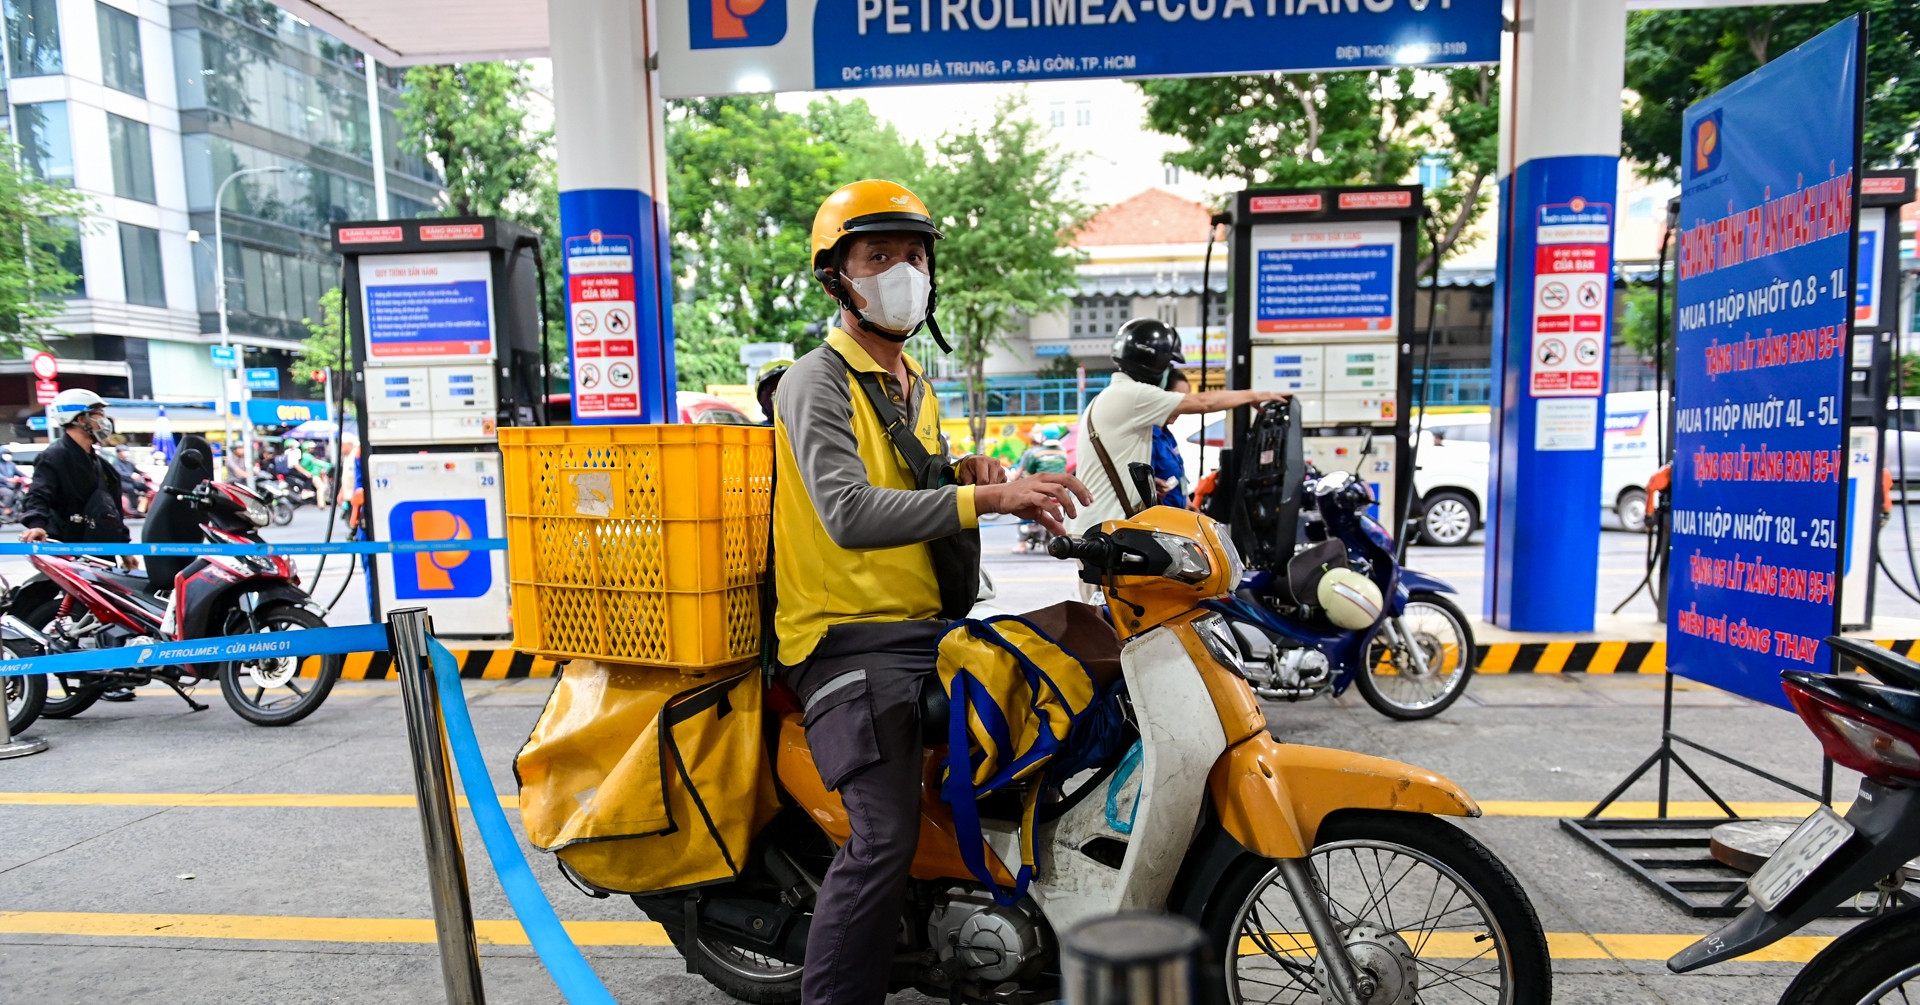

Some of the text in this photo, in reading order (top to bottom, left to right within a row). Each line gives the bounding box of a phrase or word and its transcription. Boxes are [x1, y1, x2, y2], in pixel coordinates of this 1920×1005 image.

[1336, 45, 1362, 62] ĐIỆN
[895, 63, 919, 78] HAI
[922, 59, 943, 77] BÀ
[1017, 56, 1040, 73] SÀI
[1104, 54, 1136, 70] HCM
[1680, 217, 1716, 281] CHƯƠNG
[1717, 200, 1744, 269] TRÌNH
[1780, 172, 1818, 250] KHÁCH
[1818, 159, 1853, 242] HÀNG
[1552, 258, 1595, 272] CỦA BẠN
[582, 286, 620, 300] CỦA BẠN
[1679, 300, 1707, 332] MUA
[1708, 300, 1715, 323] 1
[1716, 288, 1744, 328] HỘP
[1748, 277, 1790, 318] NHỚT
[1791, 275, 1818, 308] 0.8
[1830, 268, 1847, 300] 1L
[1706, 323, 1848, 381] TẶNG 1 LÍT XĂNG RON 95-V
[1676, 408, 1702, 434] MUA
[1704, 406, 1711, 432] 1
[1712, 398, 1740, 438] HỘP
[1742, 394, 1784, 430] NHỚT
[1786, 398, 1804, 428] 4L
[1818, 396, 1838, 426] 5L
[1374, 461, 1390, 472] 22
[1693, 444, 1842, 487] TẶNG 03 LÍT XĂNG RON 95-V
[1854, 452, 1870, 464] 24
[376, 478, 388, 488] 19
[480, 476, 494, 486] 20
[1672, 509, 1697, 536] MUA
[1698, 510, 1704, 536] 1
[1704, 506, 1732, 544] HỘP
[1734, 508, 1773, 542] NHỚT
[1774, 517, 1798, 545] 18L
[1810, 518, 1838, 549] 25L
[1690, 548, 1836, 606] TẶNG 05 LÍT XĂNG RON 95-V
[158, 646, 220, 659] PETROLIMEX
[226, 642, 248, 654] CỬA
[250, 640, 278, 652] HÀNG
[279, 640, 291, 650] 01
[1706, 614, 1726, 642] PHÍ
[1728, 616, 1770, 654] CÔNG
[1774, 632, 1819, 664] THAY
[21, 662, 34, 670] 01
